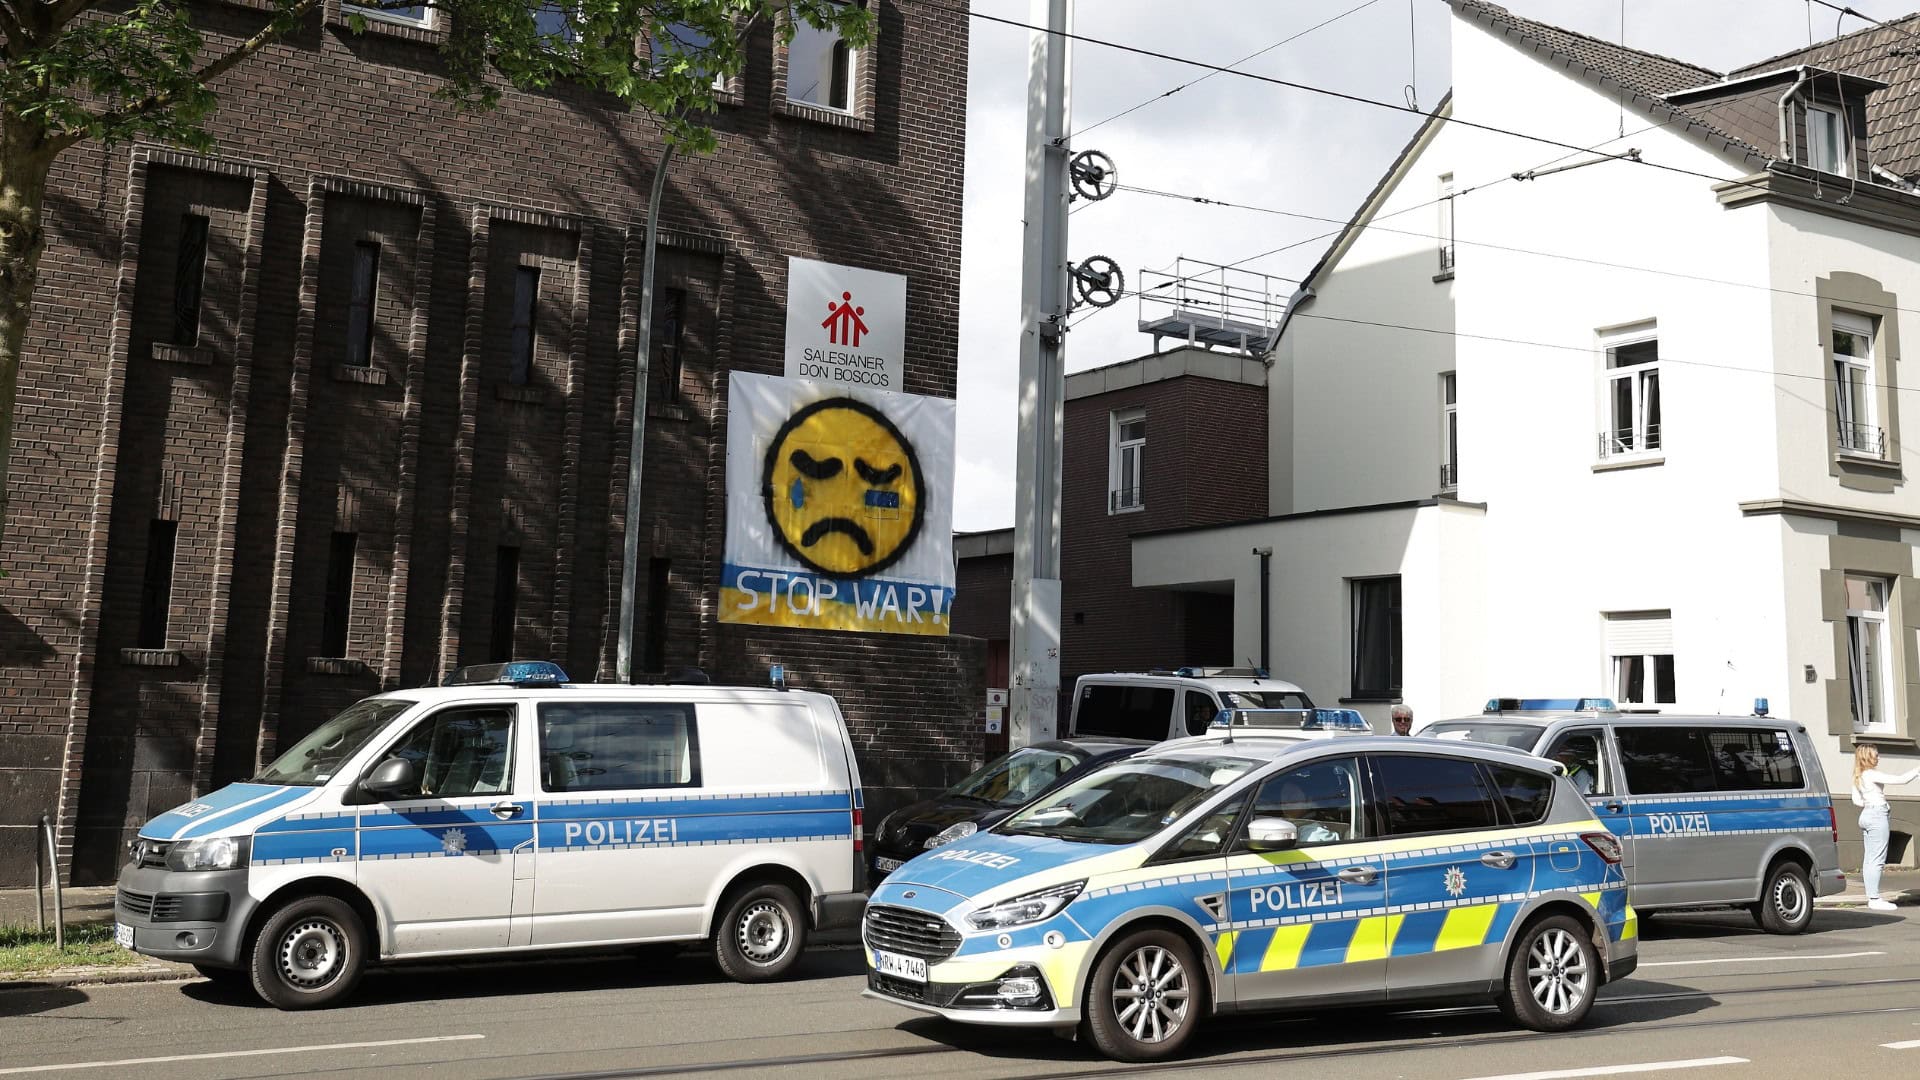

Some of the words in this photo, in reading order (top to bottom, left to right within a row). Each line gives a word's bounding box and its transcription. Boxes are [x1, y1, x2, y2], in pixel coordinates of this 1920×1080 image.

[803, 348, 885, 371] SALESIANER
[799, 362, 829, 379] DON
[834, 367, 889, 387] BOSCOS
[736, 570, 838, 617] STOP
[853, 582, 944, 625] WAR!
[565, 818, 677, 846] POLIZEI
[1648, 812, 1710, 834] POLIZEI
[928, 849, 1021, 870] POLIZEI
[1250, 880, 1343, 913] POLIZEI
